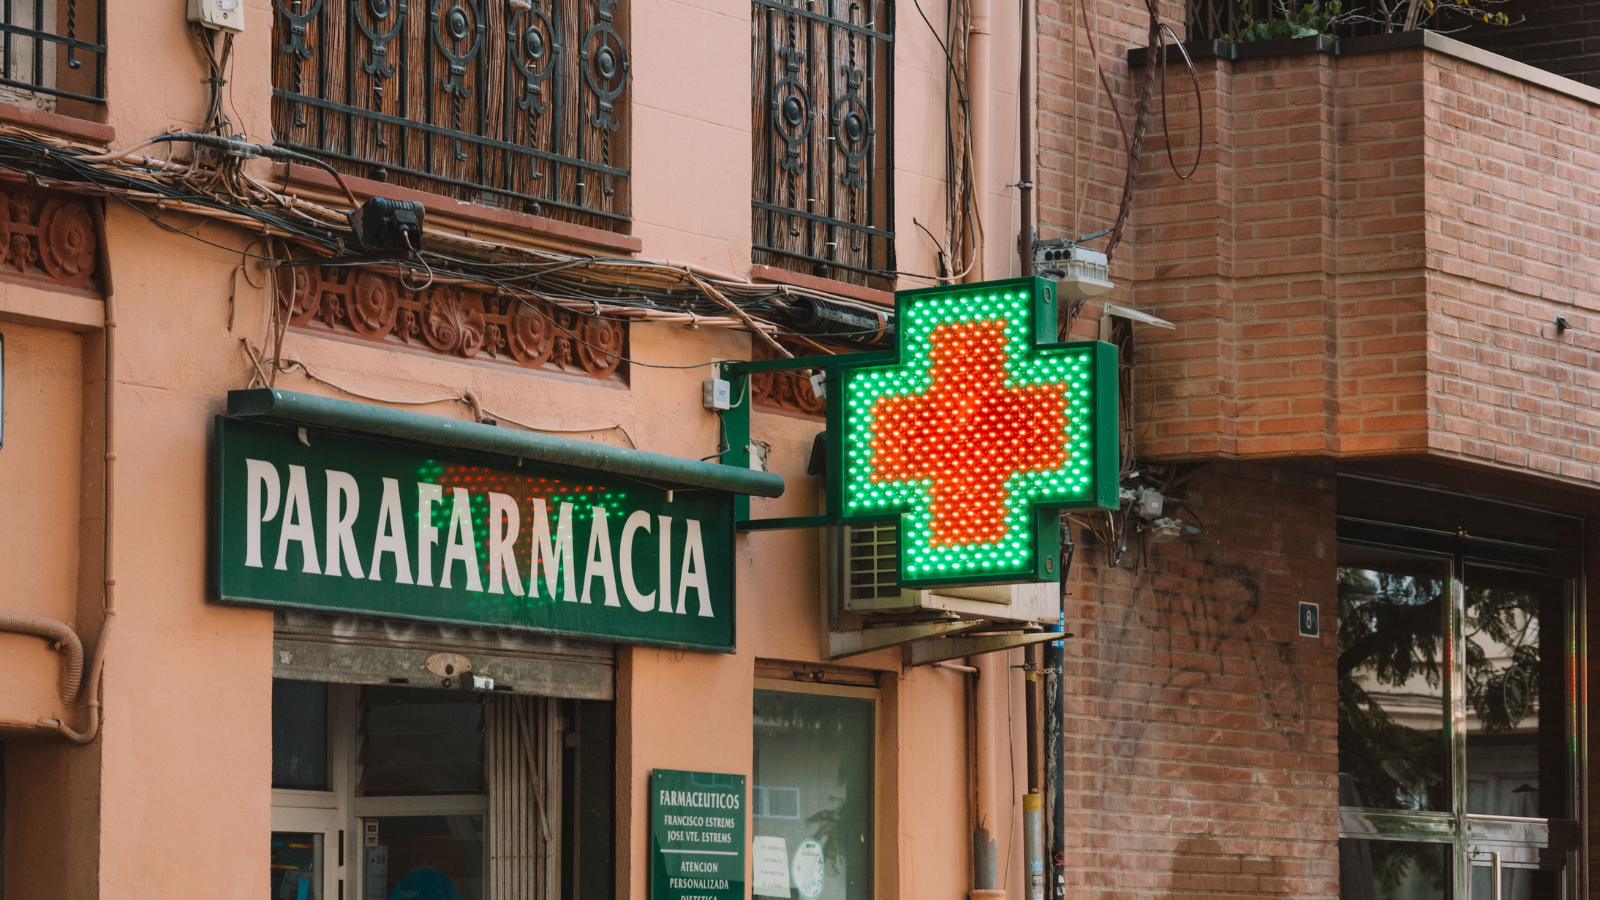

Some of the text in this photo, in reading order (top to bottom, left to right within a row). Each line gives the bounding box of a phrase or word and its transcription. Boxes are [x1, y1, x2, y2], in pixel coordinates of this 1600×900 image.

[245, 458, 714, 617] PARAFARMACIA
[1306, 609, 1312, 630] 8
[660, 790, 740, 810] FARMACEUTICOS
[664, 815, 735, 828] FRANCISCO ESTREMS
[668, 830, 731, 843] JOSE VTE. ESTREMS
[681, 861, 718, 873] ATENCION
[669, 877, 729, 890] PERSONALIZADA
